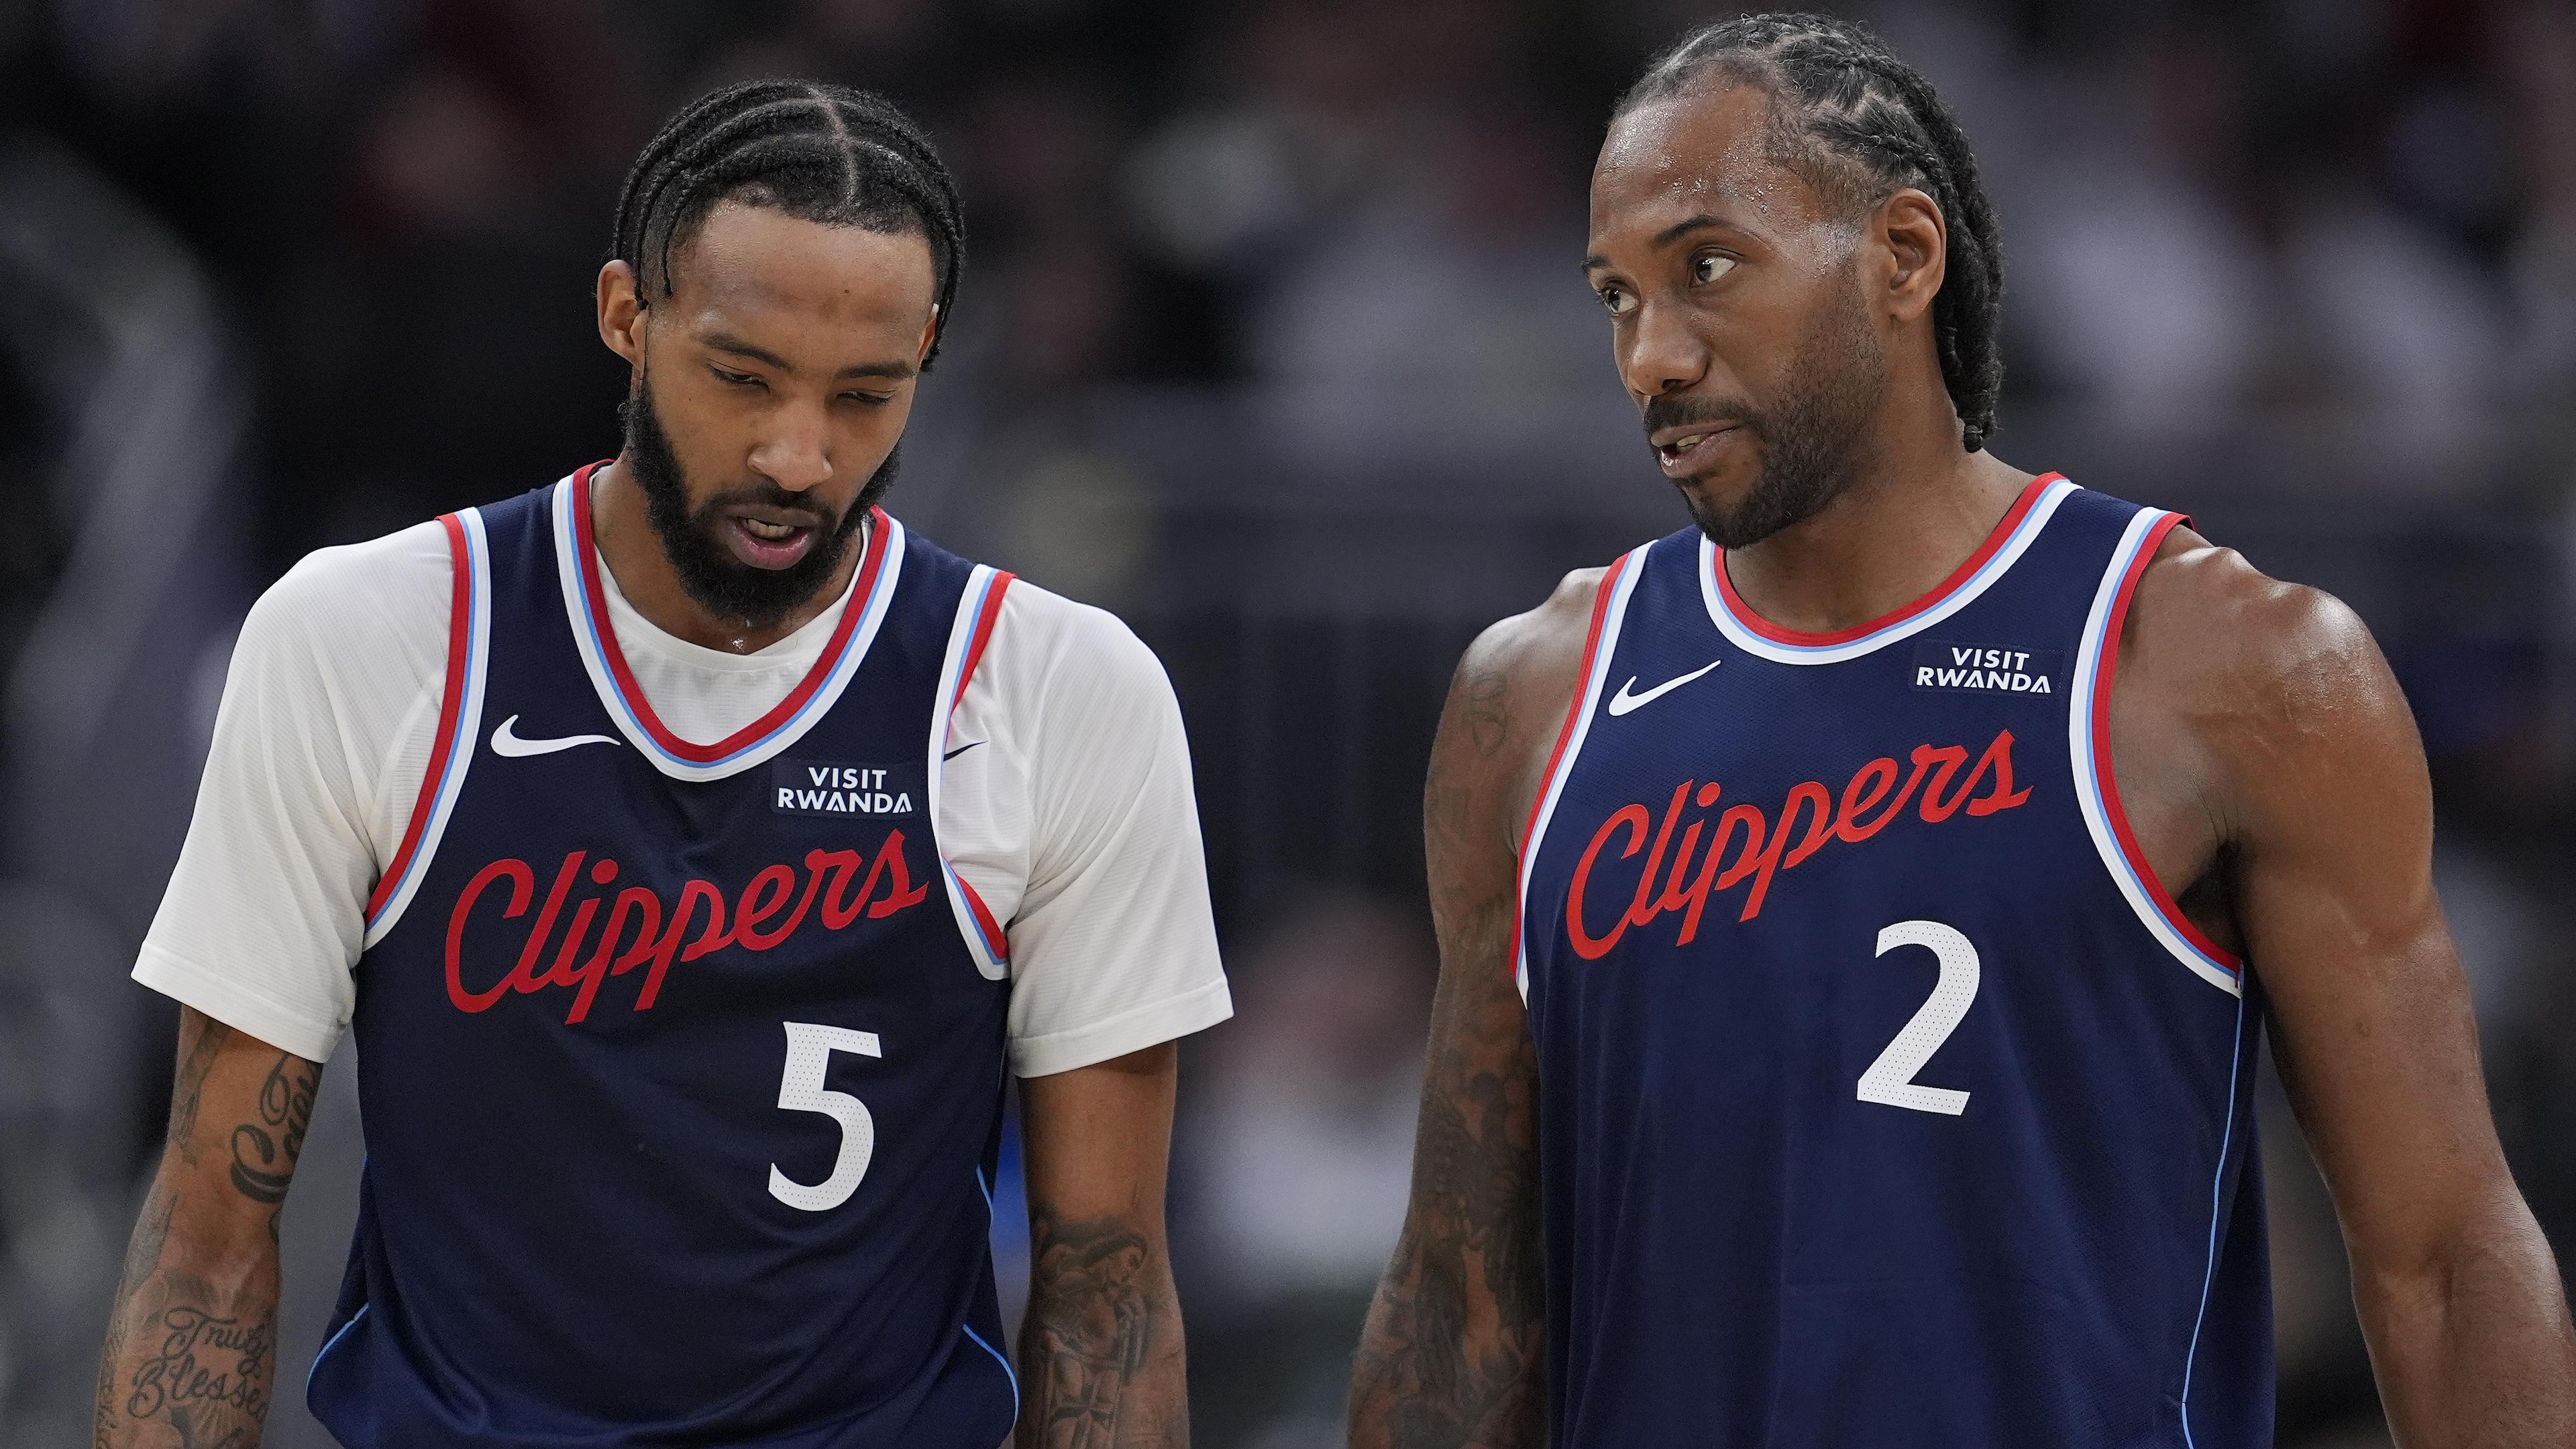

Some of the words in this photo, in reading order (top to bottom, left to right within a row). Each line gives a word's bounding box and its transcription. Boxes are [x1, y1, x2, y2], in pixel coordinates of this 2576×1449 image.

[1916, 666, 2051, 694] RWANDA
[1951, 647, 2030, 671] VISIT
[777, 787, 913, 814] RWANDA
[808, 767, 887, 790] VISIT
[1566, 729, 2034, 960] Clippers
[445, 829, 929, 1024] Clippers
[1856, 920, 1981, 1116] 2
[768, 1021, 882, 1212] 5
